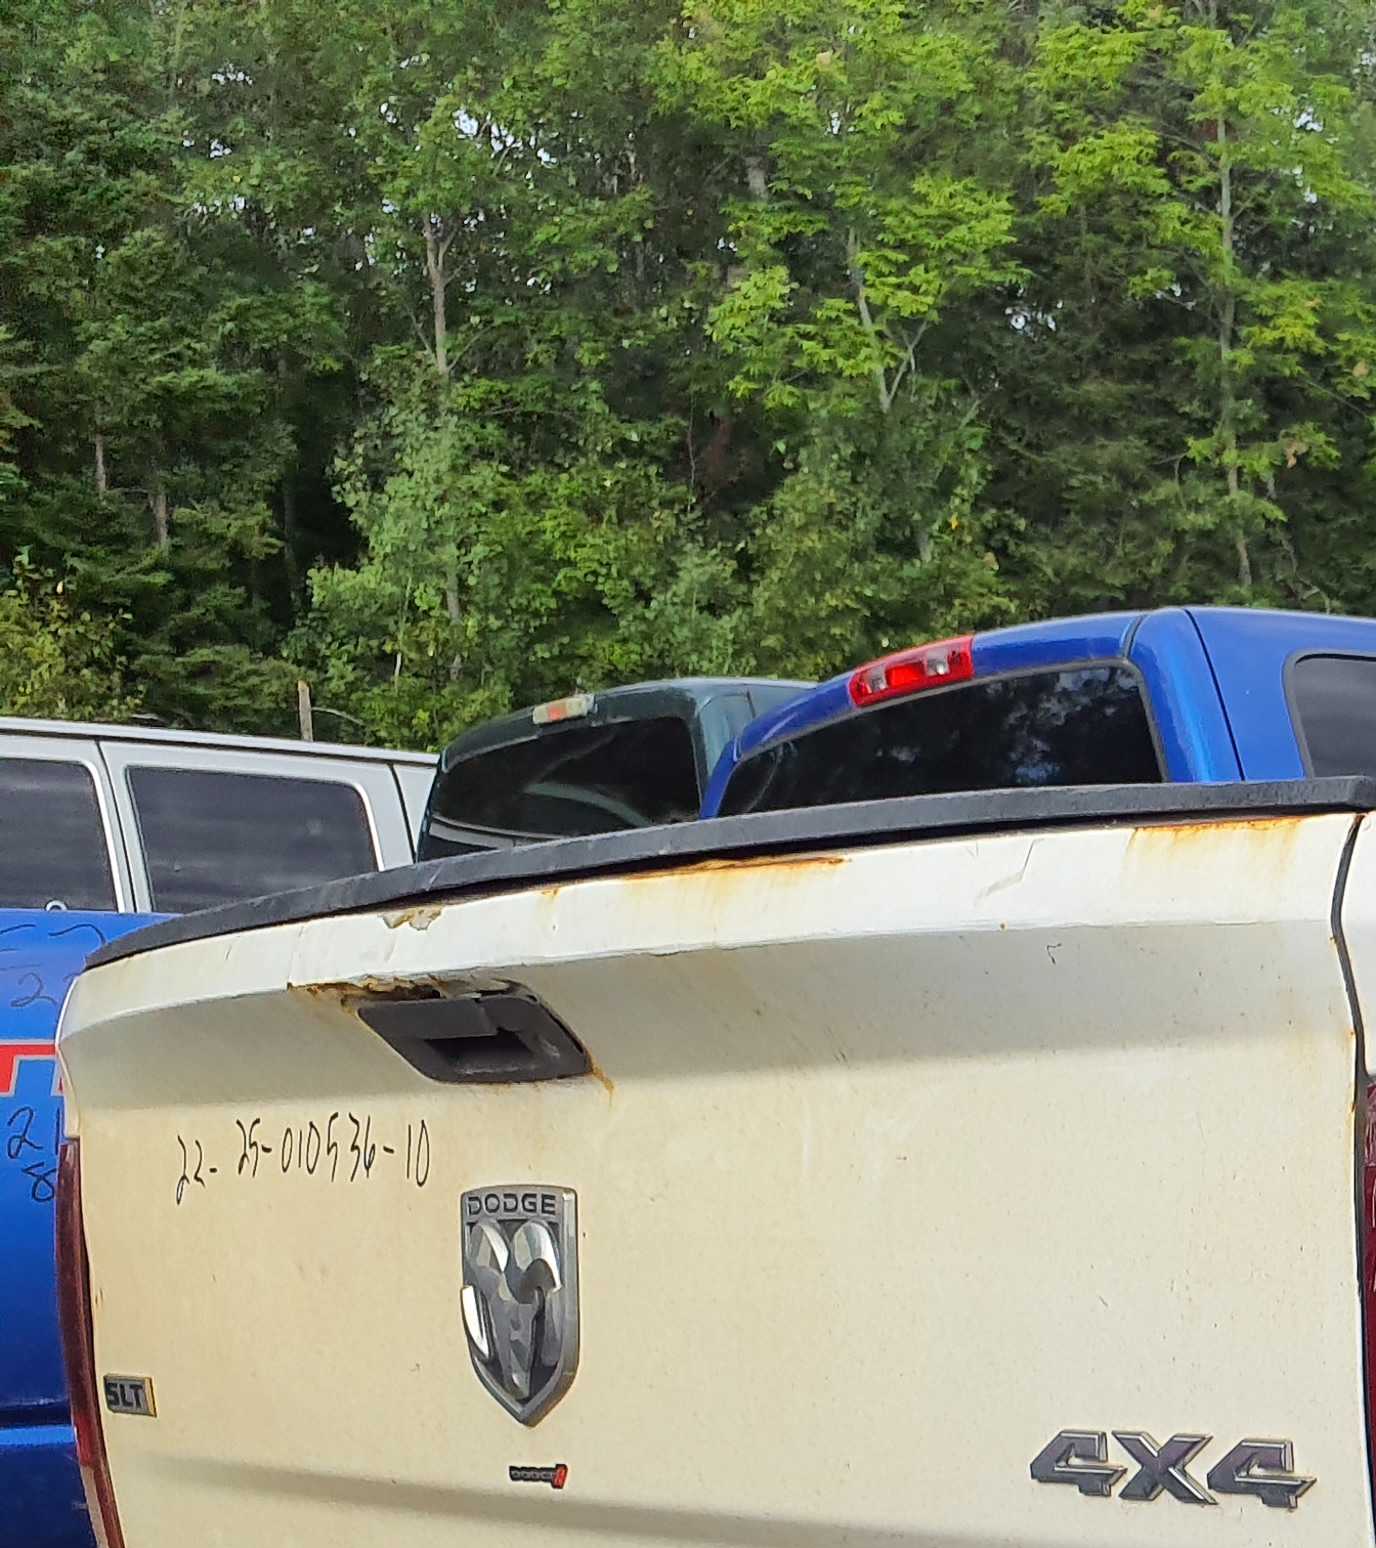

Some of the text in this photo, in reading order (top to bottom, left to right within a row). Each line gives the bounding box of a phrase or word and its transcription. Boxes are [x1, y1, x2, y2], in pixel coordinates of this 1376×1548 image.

[467, 1192, 557, 1216] DODGE
[106, 1381, 144, 1409] SLT
[1030, 1430, 1318, 1510] 4X4
